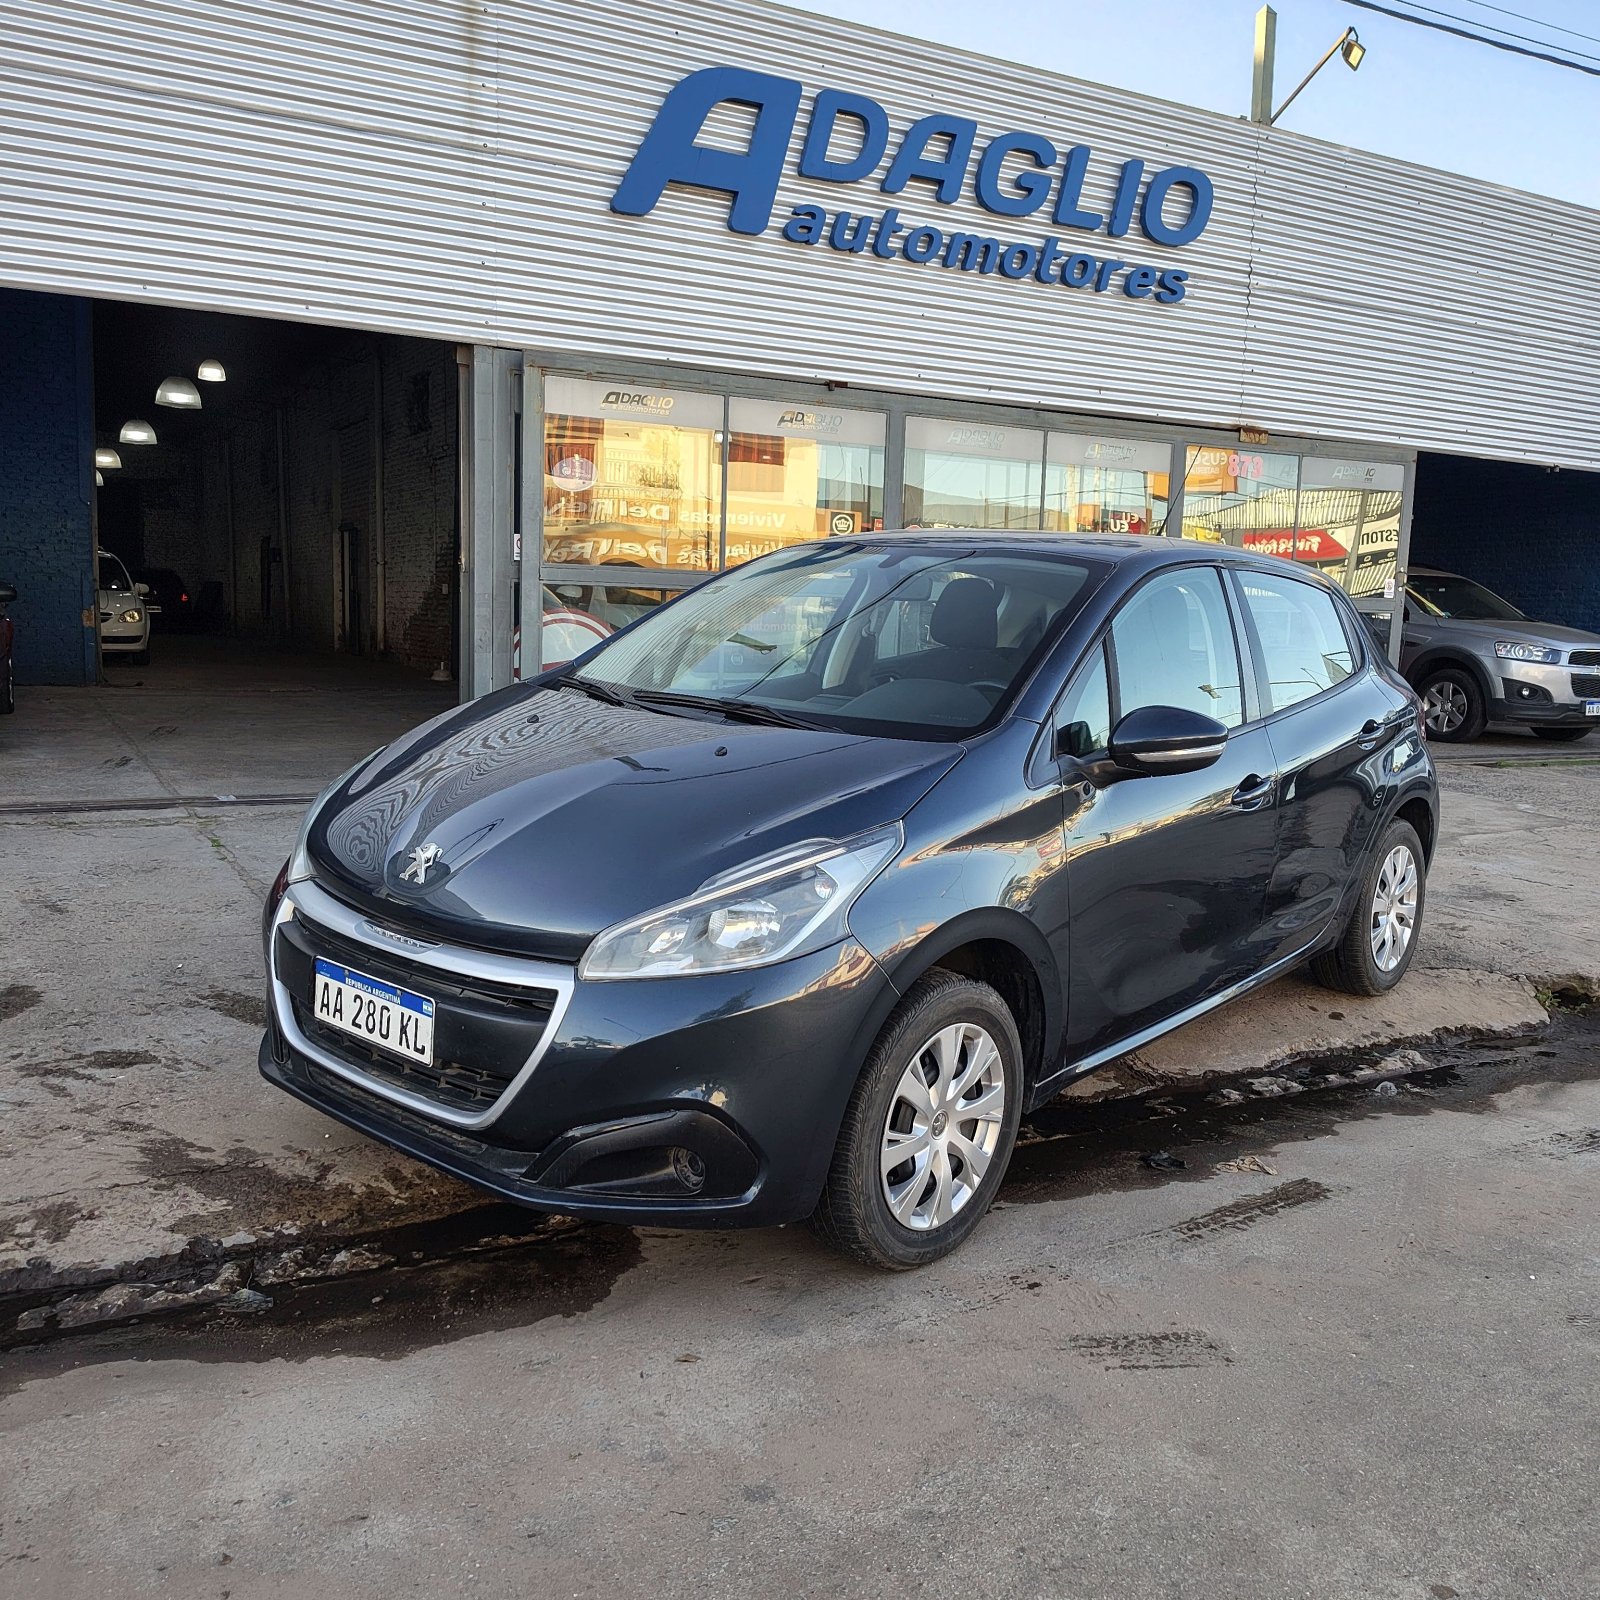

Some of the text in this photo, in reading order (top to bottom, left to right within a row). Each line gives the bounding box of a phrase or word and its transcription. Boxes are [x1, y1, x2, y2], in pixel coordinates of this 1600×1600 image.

[610, 67, 1214, 247] ADAGLIO
[782, 203, 1190, 304] automotores
[601, 391, 674, 409] ADAGLIO
[617, 404, 670, 416] automotores
[345, 976, 401, 1005] REPUBLICA ARGENTINA
[320, 981, 426, 1056] AA 280 KL
